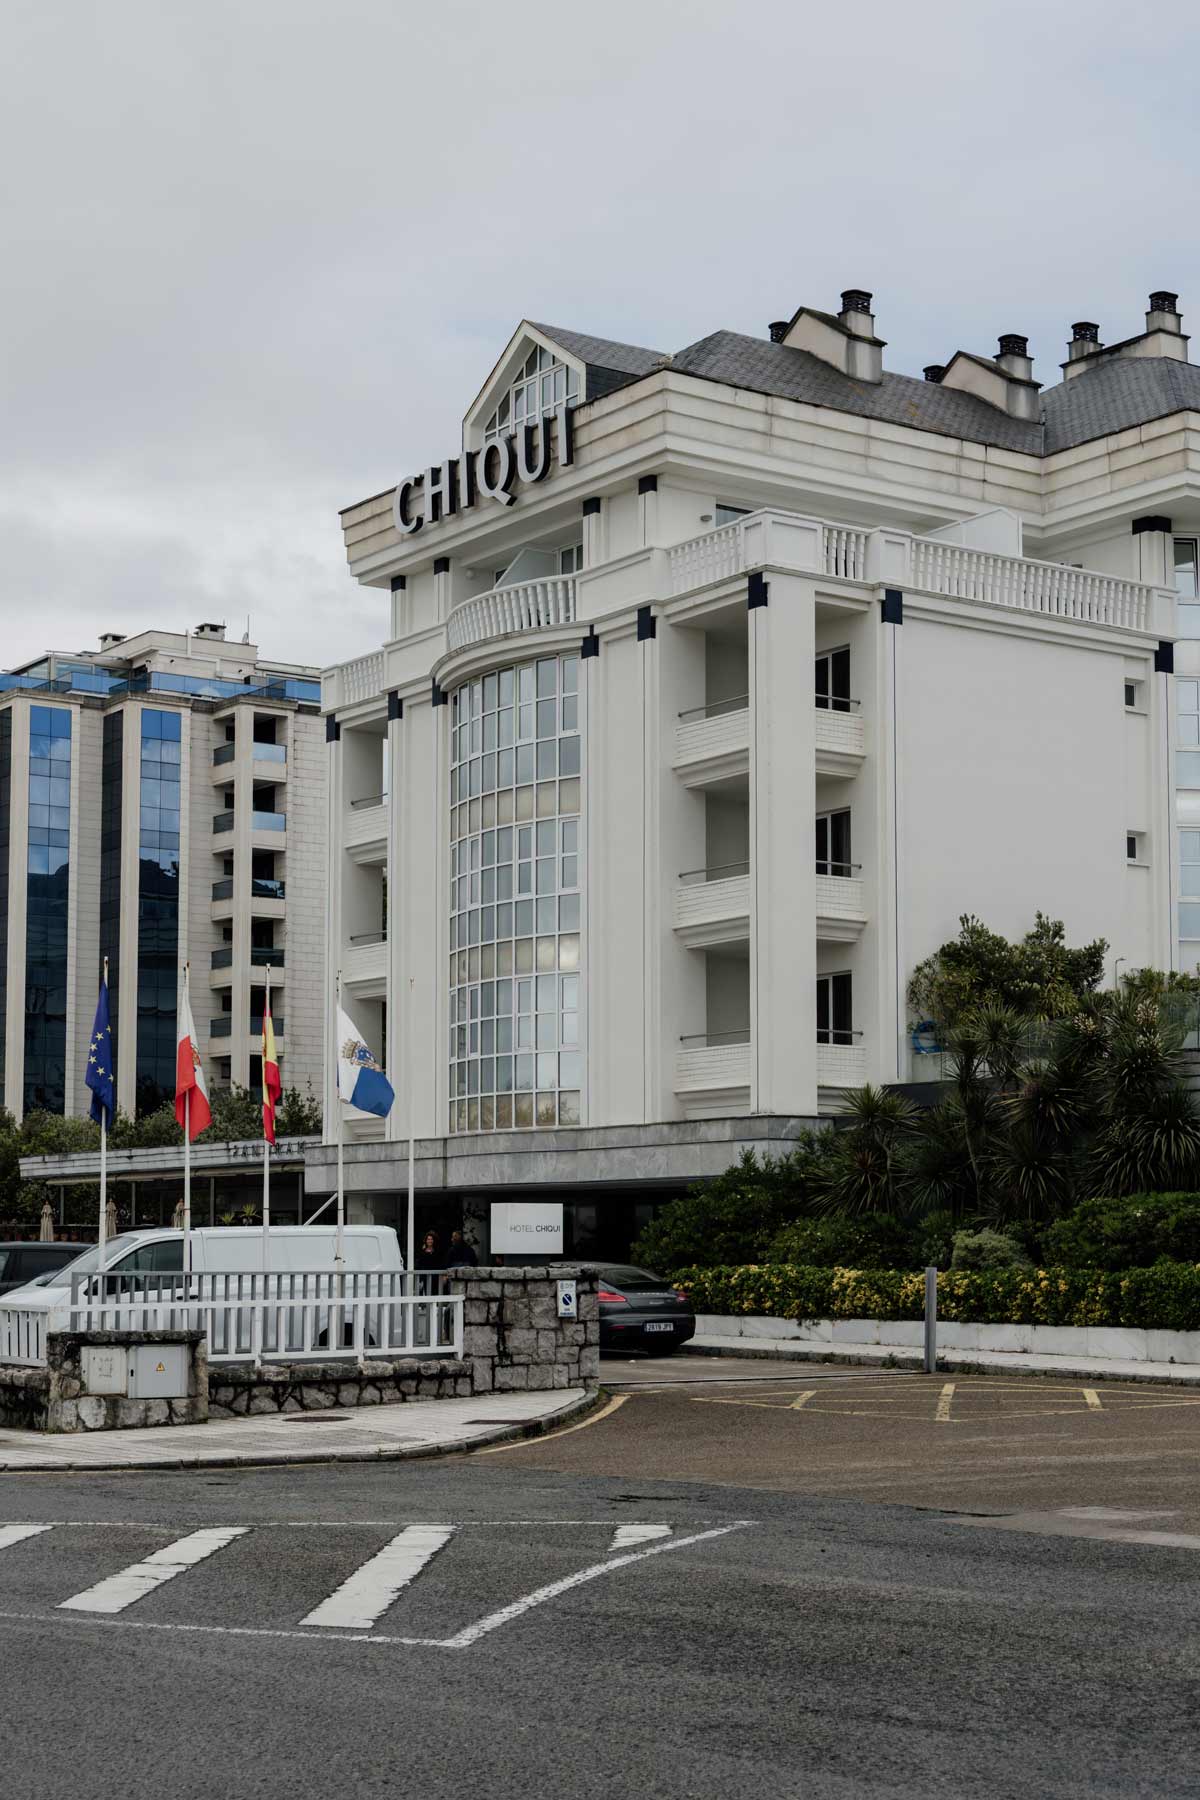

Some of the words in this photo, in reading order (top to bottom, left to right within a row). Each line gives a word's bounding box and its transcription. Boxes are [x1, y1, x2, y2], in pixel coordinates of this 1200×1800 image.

[393, 407, 573, 534] CHIQUI
[510, 1224, 534, 1233] HOTEL
[535, 1224, 561, 1233] CHIQUI
